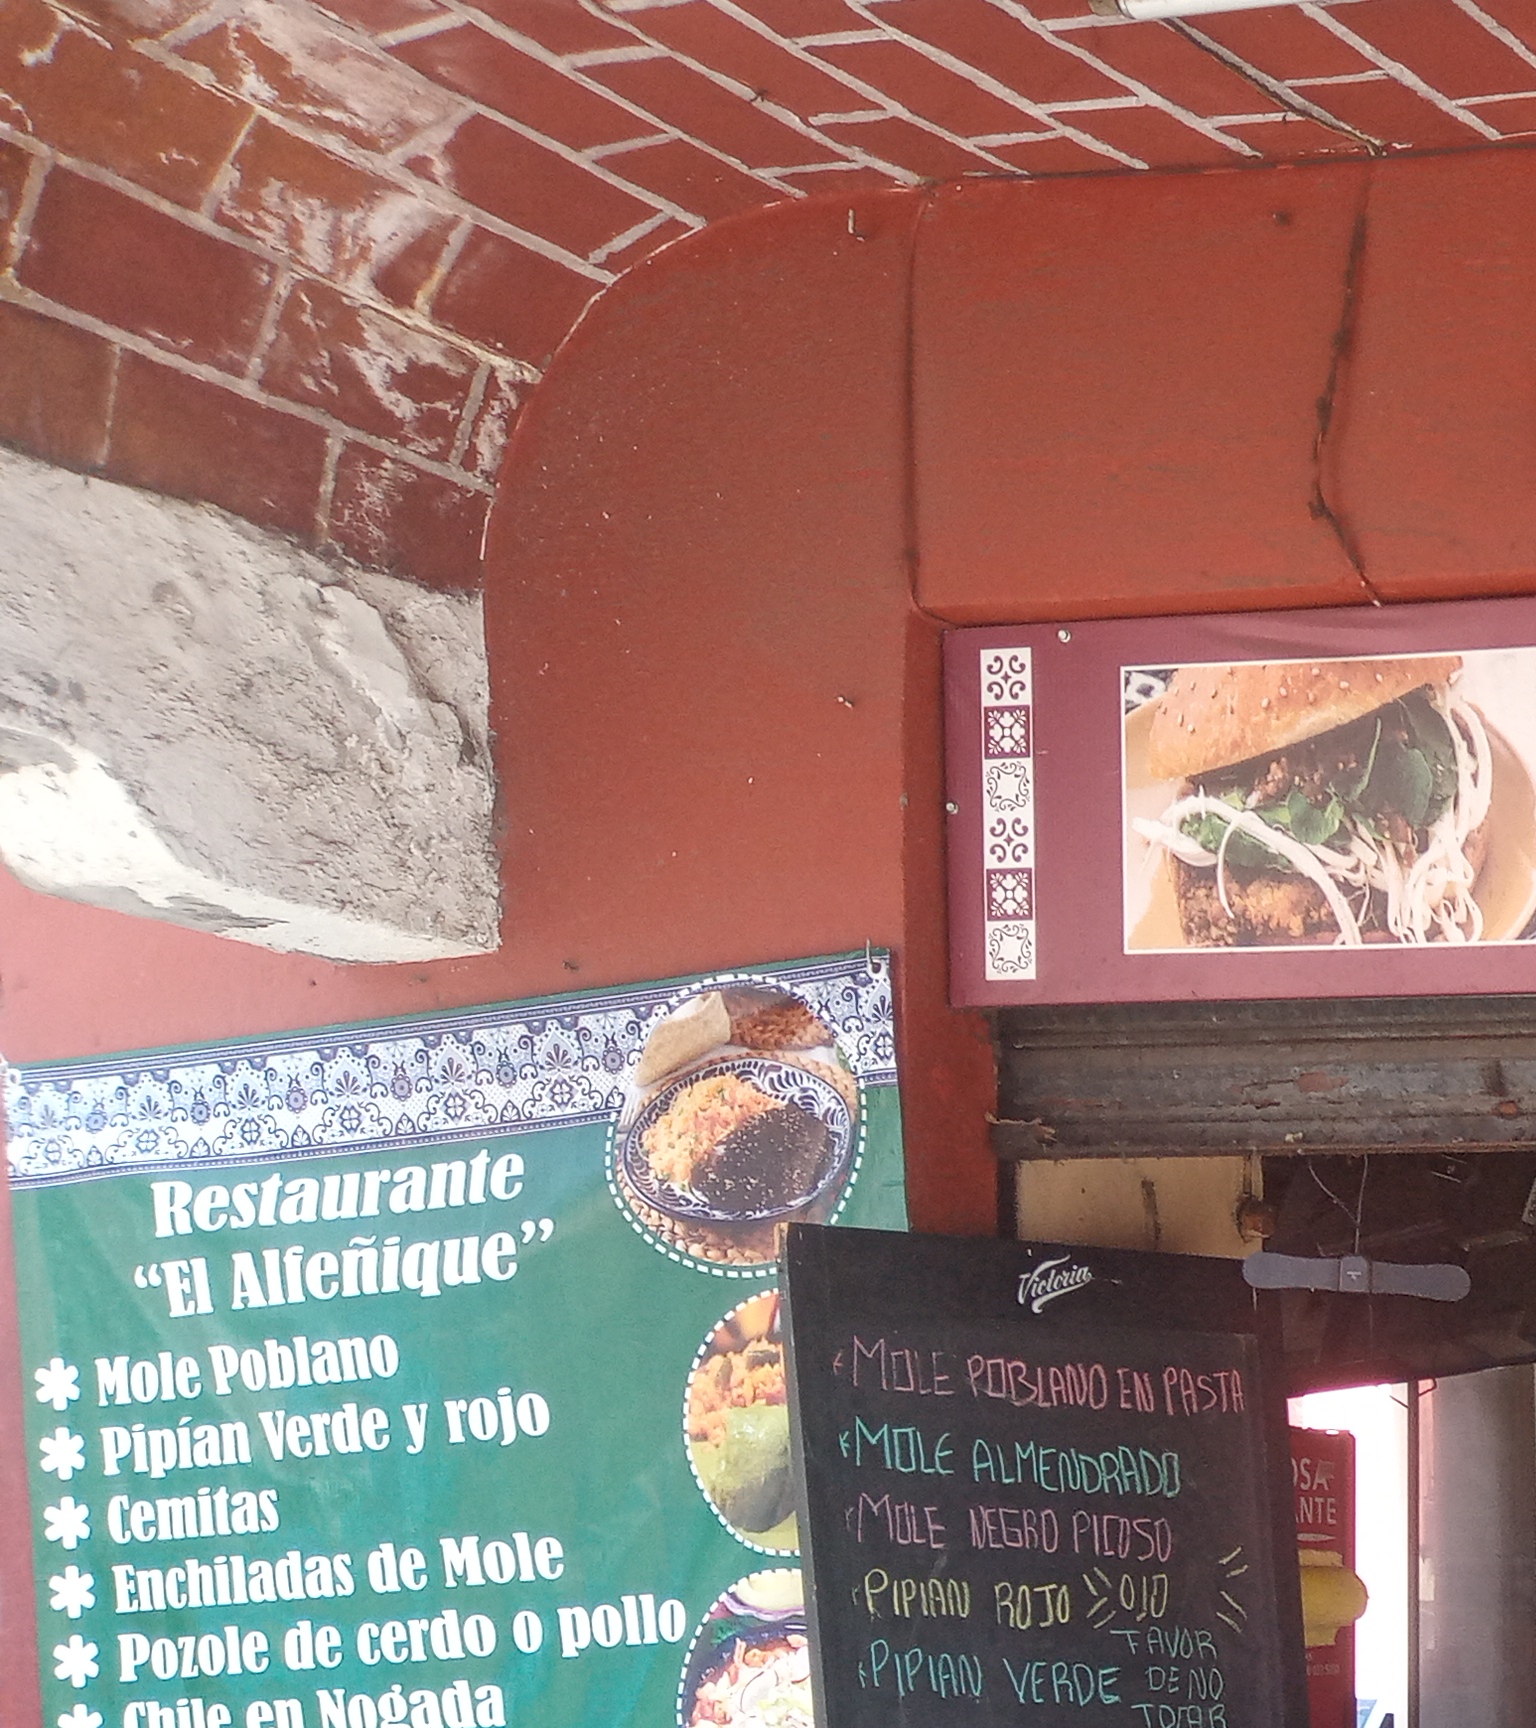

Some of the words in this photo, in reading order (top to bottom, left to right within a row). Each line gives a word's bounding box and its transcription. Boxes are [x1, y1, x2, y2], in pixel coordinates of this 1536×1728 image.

[151, 1149, 525, 1239] Restaurante
[1016, 1253, 1094, 1314] Victoria
[94, 1353, 202, 1407] Mole
[207, 1333, 399, 1396] Poblano
[852, 1335, 955, 1397] MOLE
[967, 1354, 1108, 1411] POBLANO
[1117, 1367, 1155, 1413] EN
[1162, 1367, 1245, 1416] PASTA
[100, 1420, 251, 1479] Pipían
[258, 1400, 391, 1461] Verde
[405, 1400, 429, 1456] y
[446, 1387, 551, 1446] rojo
[855, 1416, 955, 1477] MOLE
[973, 1438, 1180, 1498] ALMENDRADO
[1291, 1457, 1328, 1491] SA
[107, 1487, 279, 1545] Cemitas
[857, 1492, 947, 1549] MOLE
[969, 1505, 1059, 1554] NEGRO
[1072, 1510, 1172, 1563] PICOSO
[1295, 1496, 1337, 1525] NTE
[113, 1547, 355, 1614] Enchiladas
[367, 1541, 429, 1591] de
[439, 1532, 565, 1588] Mole
[864, 1568, 970, 1620] PIPIAN
[994, 1581, 1070, 1630] ROJO
[118, 1627, 270, 1682] Pozole
[284, 1621, 343, 1670] de
[356, 1607, 496, 1665] cerdo
[512, 1610, 543, 1653] o
[557, 1594, 687, 1657] pollo
[869, 1638, 983, 1699] PIPIAN
[1002, 1657, 1121, 1707] VERDE
[1109, 1626, 1218, 1660] FAVOR
[1145, 1666, 1180, 1693] DE
[1188, 1667, 1225, 1701] NO
